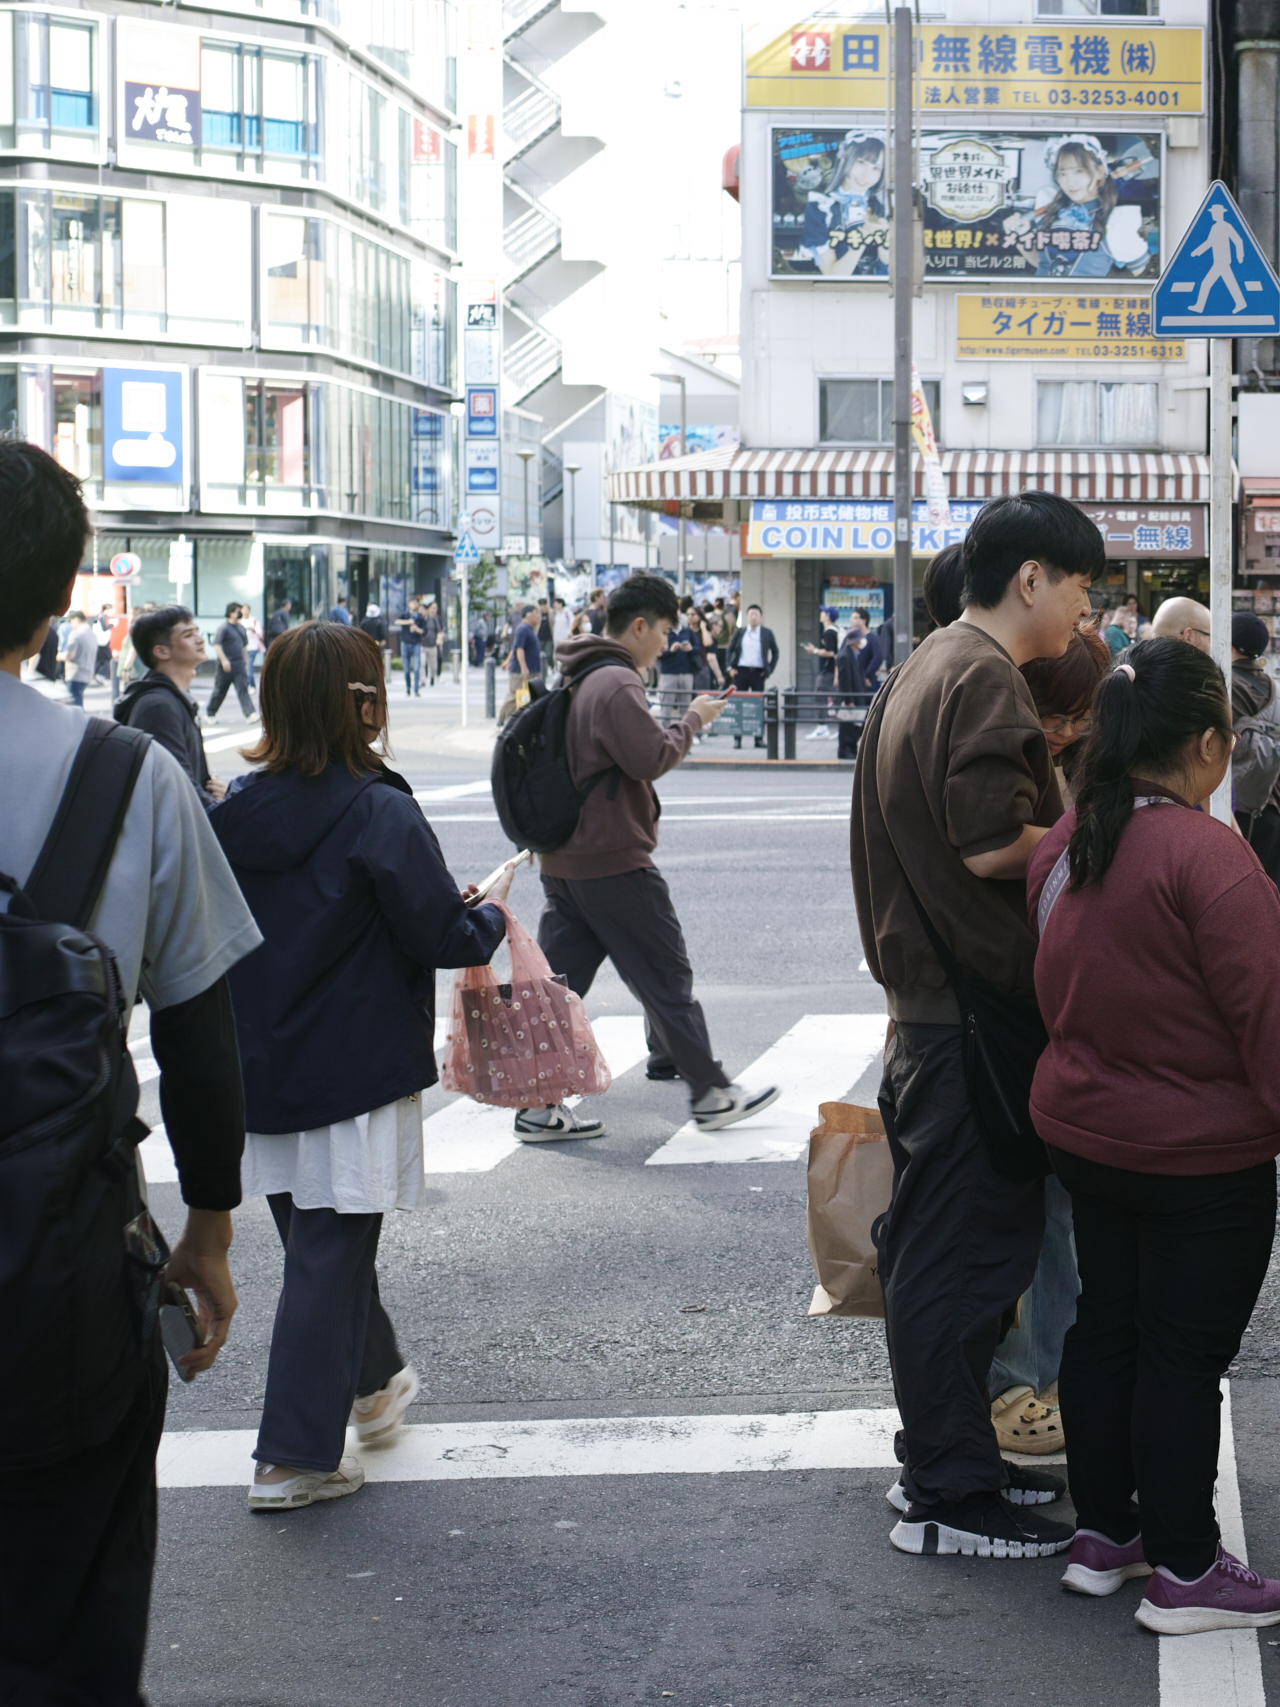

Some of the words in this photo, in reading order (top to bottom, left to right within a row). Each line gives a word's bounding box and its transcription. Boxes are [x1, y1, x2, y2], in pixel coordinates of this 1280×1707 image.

[843, 33, 1156, 76] 田無線電機(株)
[925, 86, 1000, 105] 法人営業
[1012, 91, 1042, 104] TEL
[1048, 89, 1179, 106] 03-3253-4001
[992, 311, 1152, 338] タイガー無線
[1093, 344, 1183, 358] 03-3251-6313
[786, 504, 889, 522] 投币式储物柜
[762, 525, 846, 550] COIN
